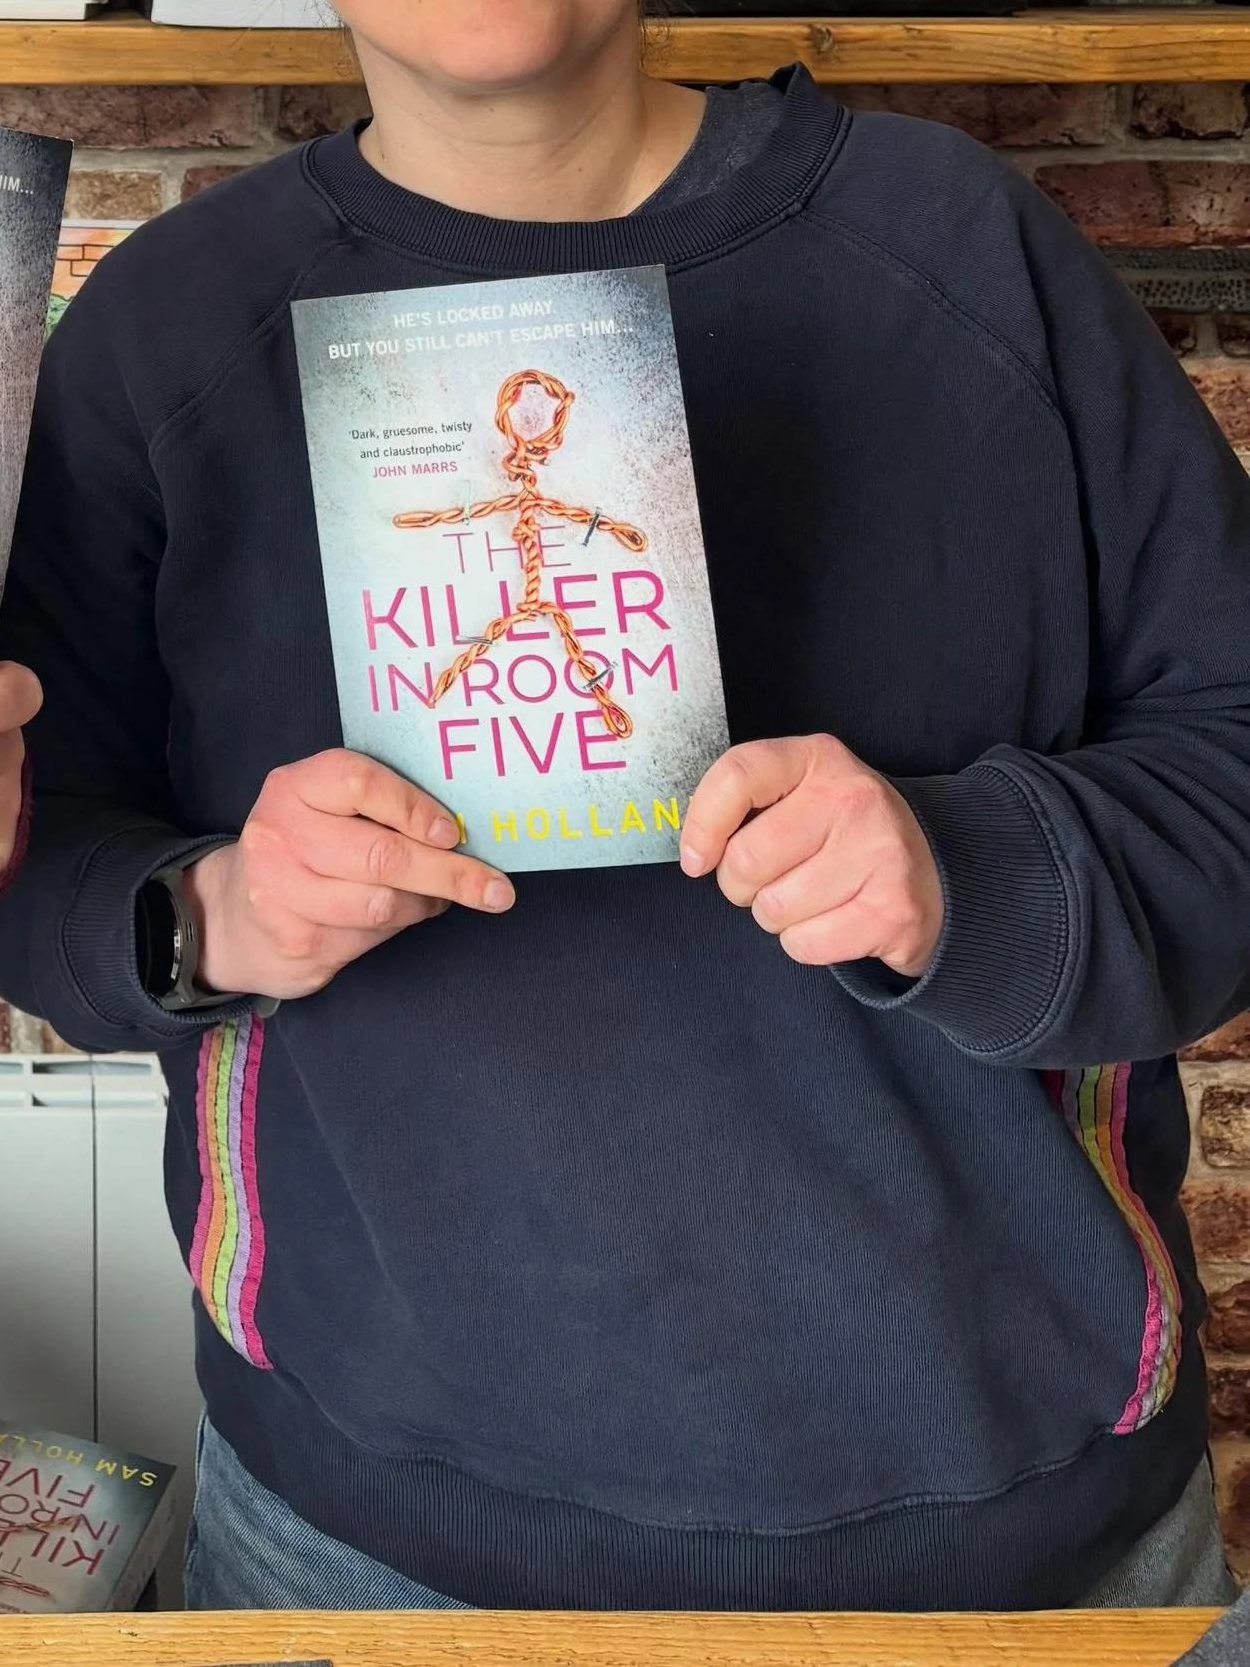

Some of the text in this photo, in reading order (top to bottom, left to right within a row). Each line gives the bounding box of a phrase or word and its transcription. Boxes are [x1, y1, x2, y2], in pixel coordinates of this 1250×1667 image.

[393, 300, 557, 329] HE'S LOCKED AWAY.
[328, 319, 634, 360] BUT YOU STILL CAN'T ESCAPE HIM...
[348, 420, 473, 441] 'Dark, gruesome, twisty
[359, 441, 466, 459] and claustrophobic'
[372, 461, 458, 478] JOHN MARRS
[442, 524, 572, 574] THE
[362, 569, 672, 651] KILLER
[367, 644, 679, 713] IN ROOM
[437, 709, 627, 780] FIVE
[492, 797, 683, 842] HOLLAN
[94, 1458, 158, 1487] SAM
[70, 1513, 120, 1545] IN
